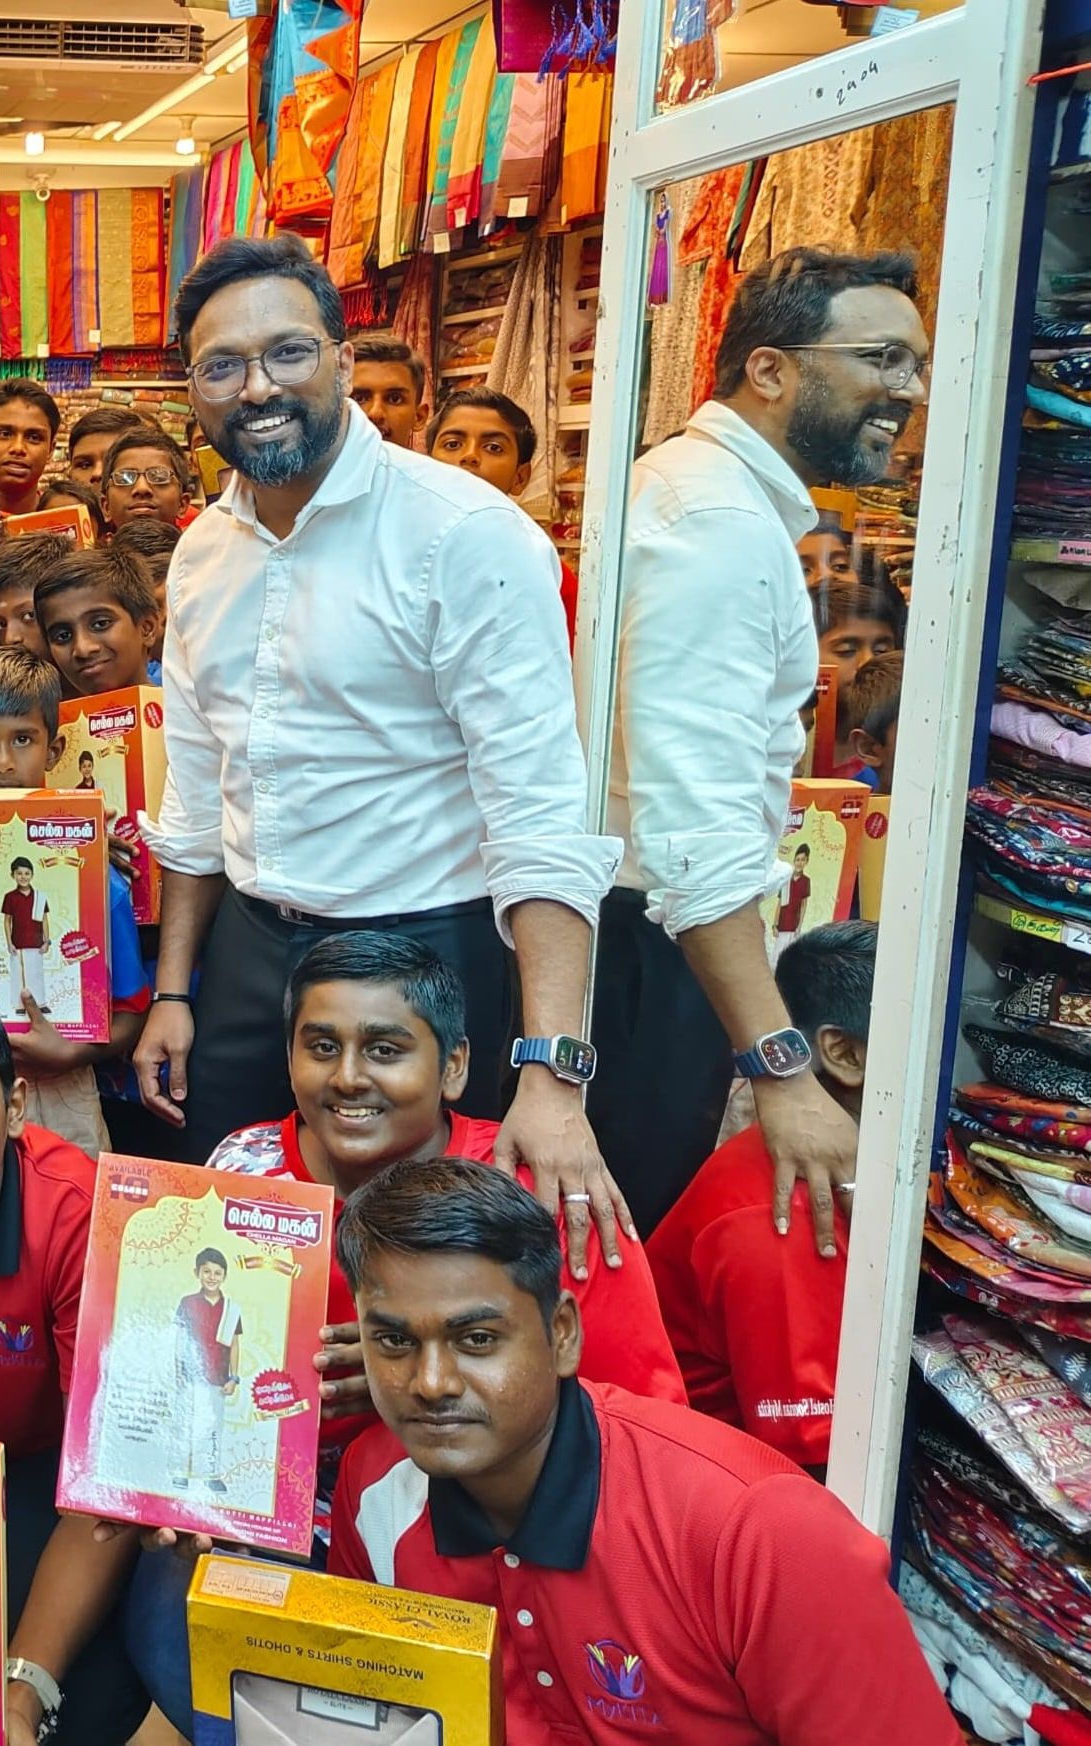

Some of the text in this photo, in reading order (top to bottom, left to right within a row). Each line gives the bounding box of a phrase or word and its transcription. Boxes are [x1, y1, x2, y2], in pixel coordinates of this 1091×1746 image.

[90, 716, 113, 733] செல்ல
[114, 709, 134, 729] மகன்
[27, 821, 63, 840] செல்ல
[64, 822, 94, 841] மகன்
[109, 1165, 152, 1177] AVAILABLE
[228, 1204, 319, 1240] செல்ல மகன்
[246, 1231, 271, 1242] CHELLA
[367, 1598, 421, 1614] CLASSIC
[427, 1609, 471, 1625] ROYAL
[246, 1635, 425, 1681] MATCHING SHIRTS & DHOTIS
